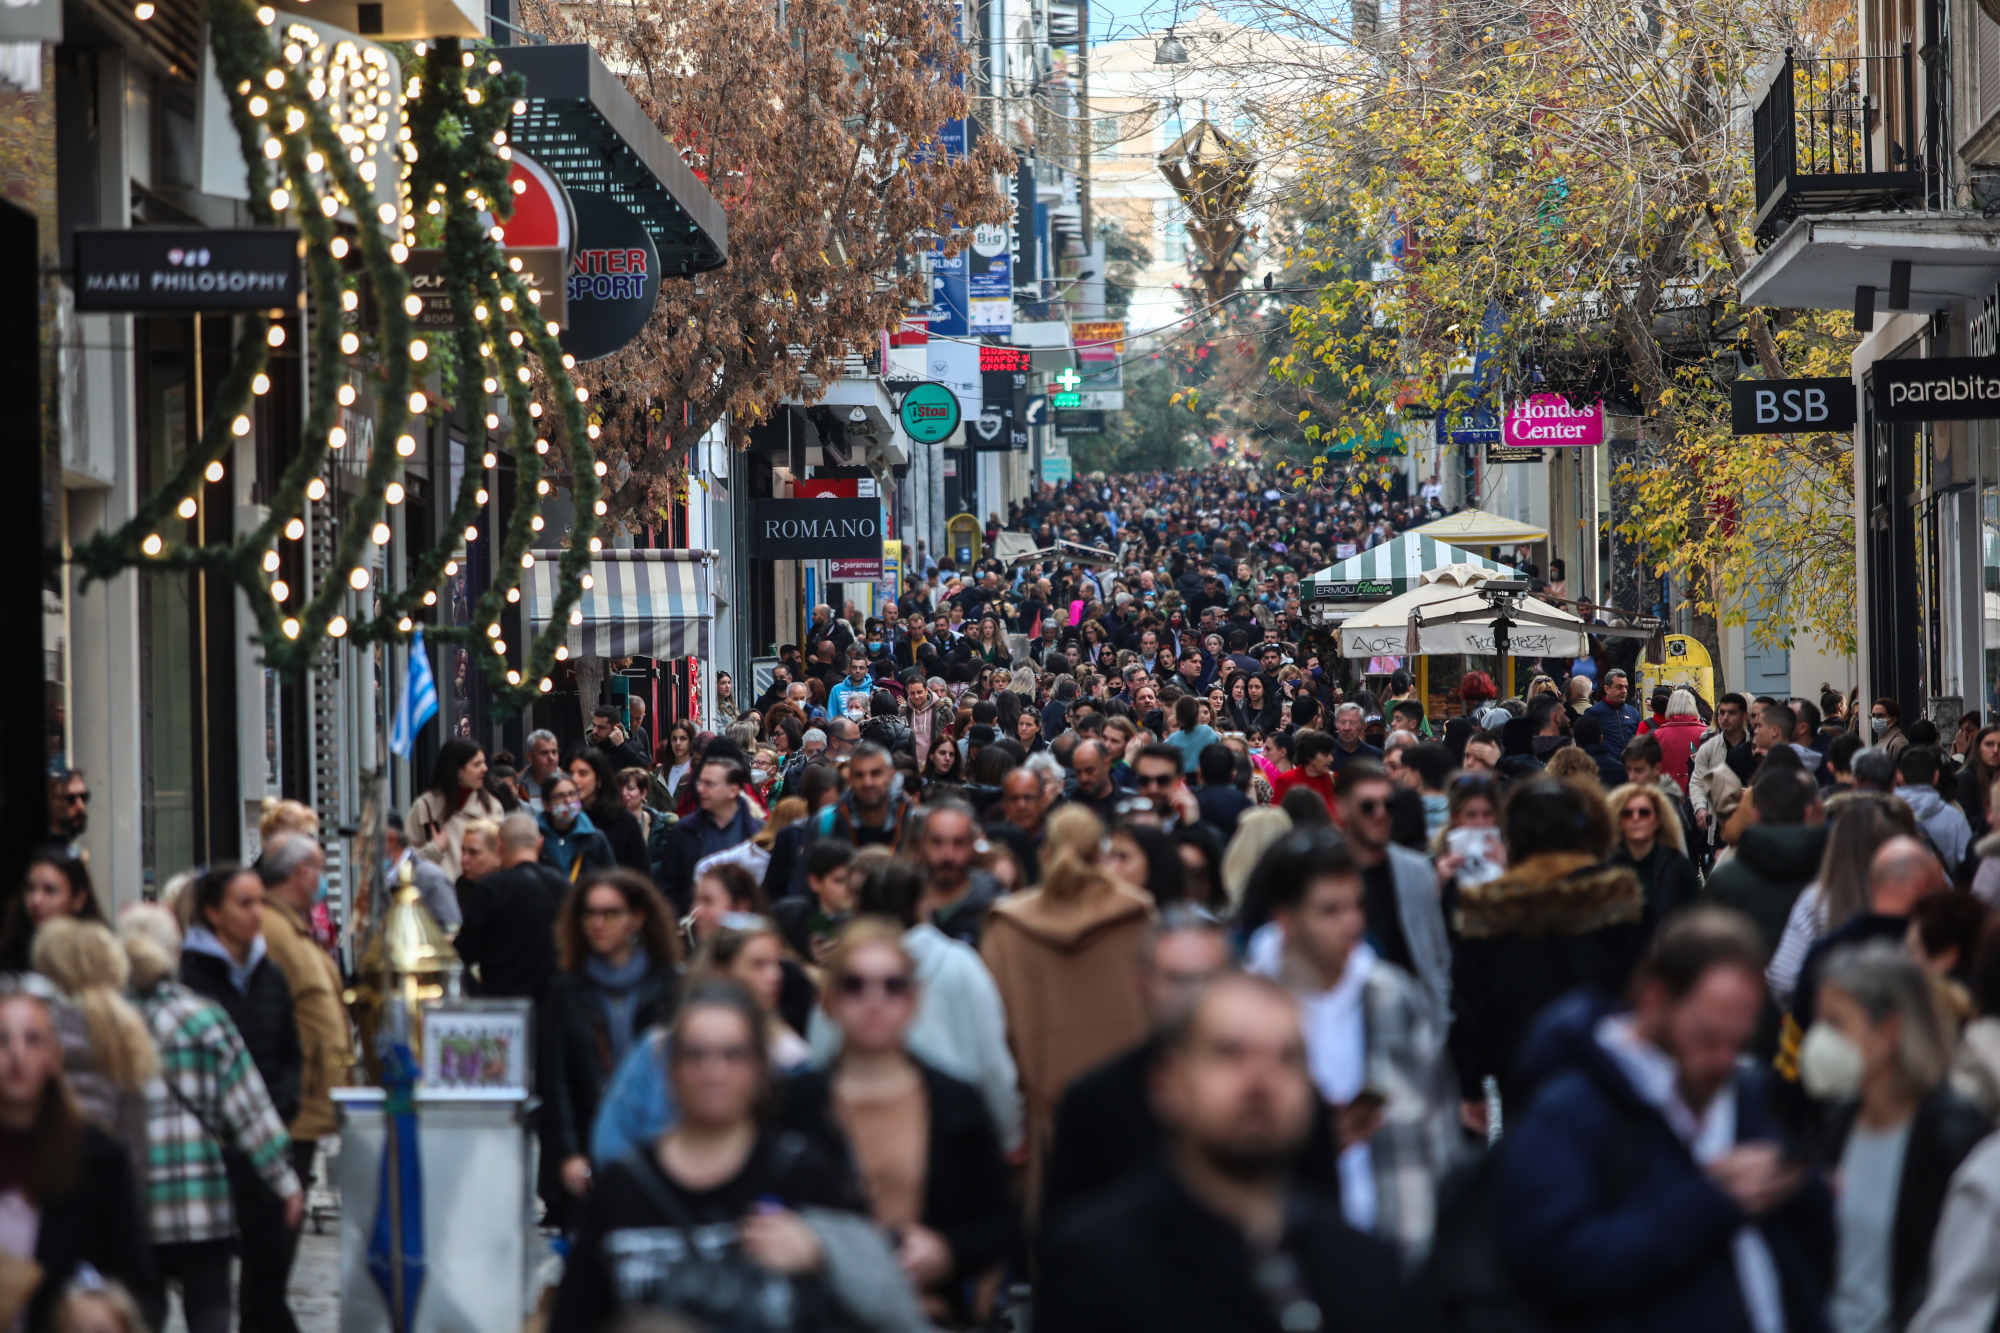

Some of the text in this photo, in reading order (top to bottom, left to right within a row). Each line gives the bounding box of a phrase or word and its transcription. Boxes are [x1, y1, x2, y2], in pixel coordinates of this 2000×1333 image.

[977, 232, 1003, 246] Big
[573, 250, 647, 274] NTER
[932, 258, 962, 268] RLIND
[86, 270, 289, 292] MAKI PHILOSOPHY
[567, 274, 648, 300] SPORT
[1889, 374, 2000, 408] parabita
[912, 405, 948, 418] iStoa
[1512, 397, 1595, 419] Hondos
[1755, 388, 1829, 425] BSB
[1512, 418, 1587, 440] Center
[764, 518, 876, 539] ROMANO
[1316, 581, 1392, 595] ERMOU Flower
